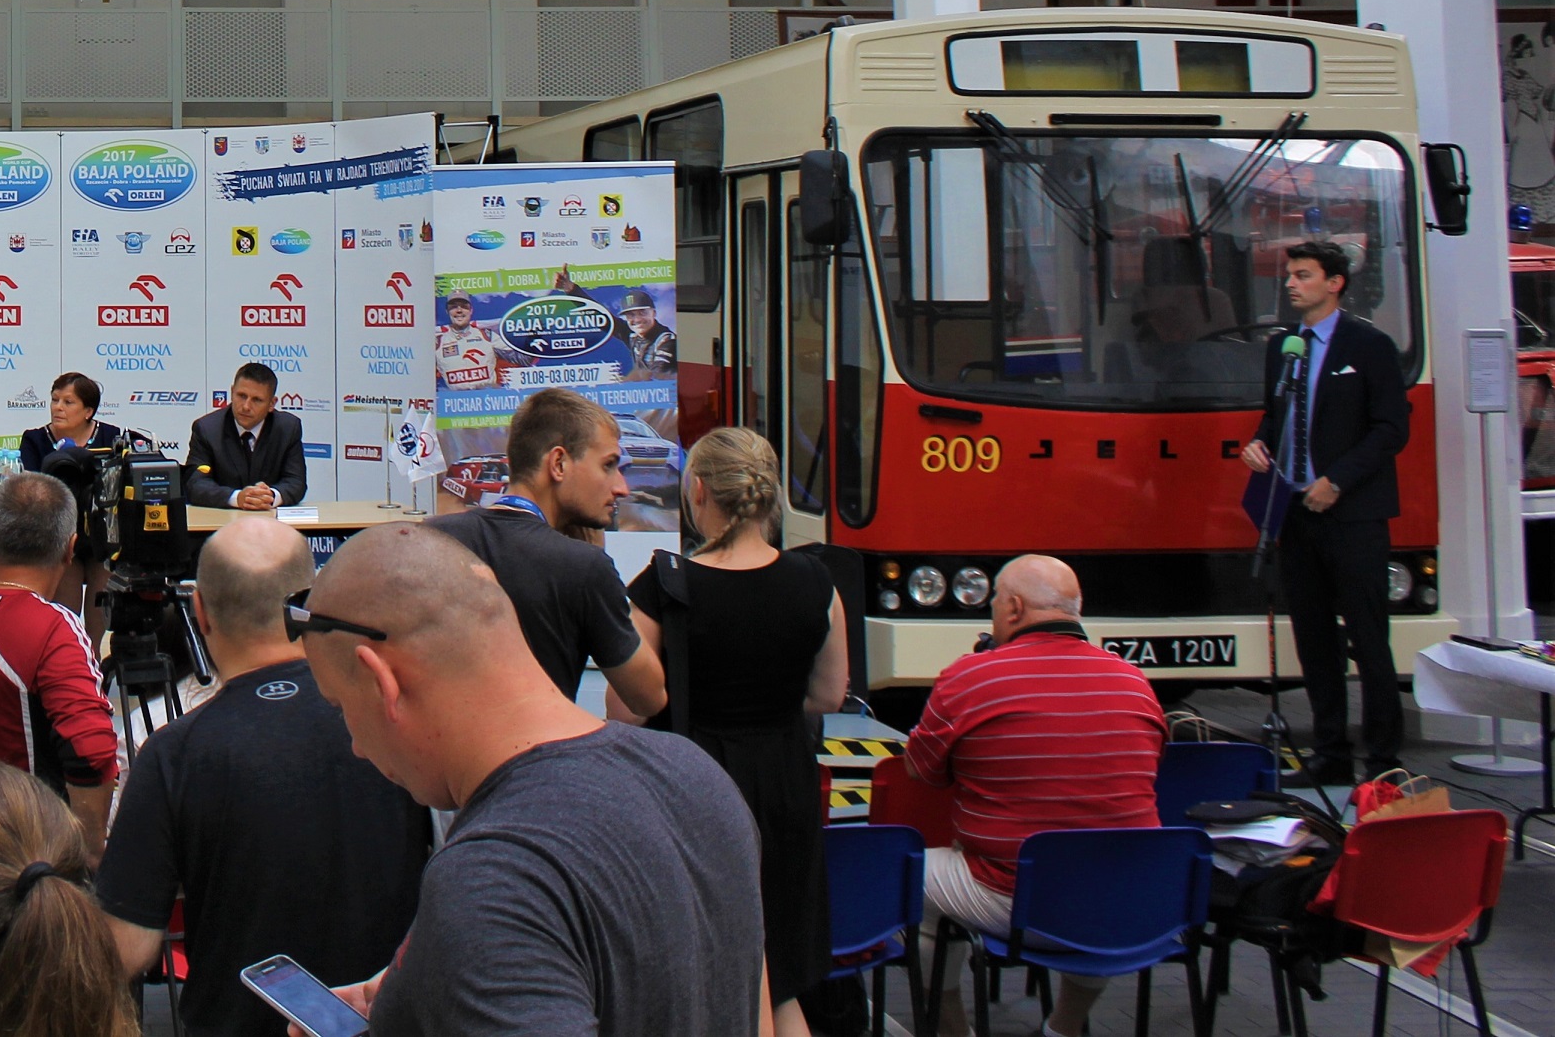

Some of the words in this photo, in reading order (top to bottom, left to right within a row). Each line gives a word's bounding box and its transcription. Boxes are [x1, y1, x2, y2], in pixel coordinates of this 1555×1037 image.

[102, 150, 136, 162] 2017
[78, 164, 118, 179] BAJA
[123, 163, 189, 179] POLAND
[241, 175, 274, 191] PUCHAR
[277, 171, 306, 188] ŚWIATA
[310, 170, 322, 184] FIA
[326, 169, 333, 182] W
[337, 165, 367, 181] RAJDACH
[370, 156, 413, 176] TERENOWYCH
[130, 191, 162, 199] ORLEN
[361, 228, 382, 237] Miasto
[361, 238, 392, 248] Szczecin
[542, 239, 578, 247] Szczecin
[450, 276, 493, 290] SZCZECIN
[508, 273, 541, 287] DOBRA
[570, 268, 615, 282] DRAWSKO
[617, 266, 673, 280] POMORSKIE
[101, 309, 165, 324] ORLEN
[244, 309, 302, 324] ORLEN
[366, 308, 412, 324] ORLEN
[526, 304, 556, 316] 2017
[506, 317, 543, 333] BAJA
[546, 313, 608, 331] POLAND
[96, 343, 172, 356] COLUMNA
[239, 343, 308, 358] COLUMNA
[553, 339, 584, 349] ORLEN
[360, 345, 414, 360] COLUMNA
[105, 358, 165, 371] MEDICA
[250, 359, 303, 373] DICA
[367, 362, 410, 375] MEDICA
[448, 367, 489, 383] ORLEN
[519, 367, 600, 385] 31.08-03.09.2017
[147, 391, 199, 402] TENZI
[444, 397, 482, 413] PUCHAR
[484, 394, 520, 411] ŚWIATA
[601, 387, 670, 405] TERENOWYCH
[8, 401, 46, 409] BARANOWSKI
[920, 434, 1001, 474] 809
[1029, 439, 1241, 459] JELC
[1104, 640, 1158, 664] SZA
[1171, 638, 1234, 664] 120V
